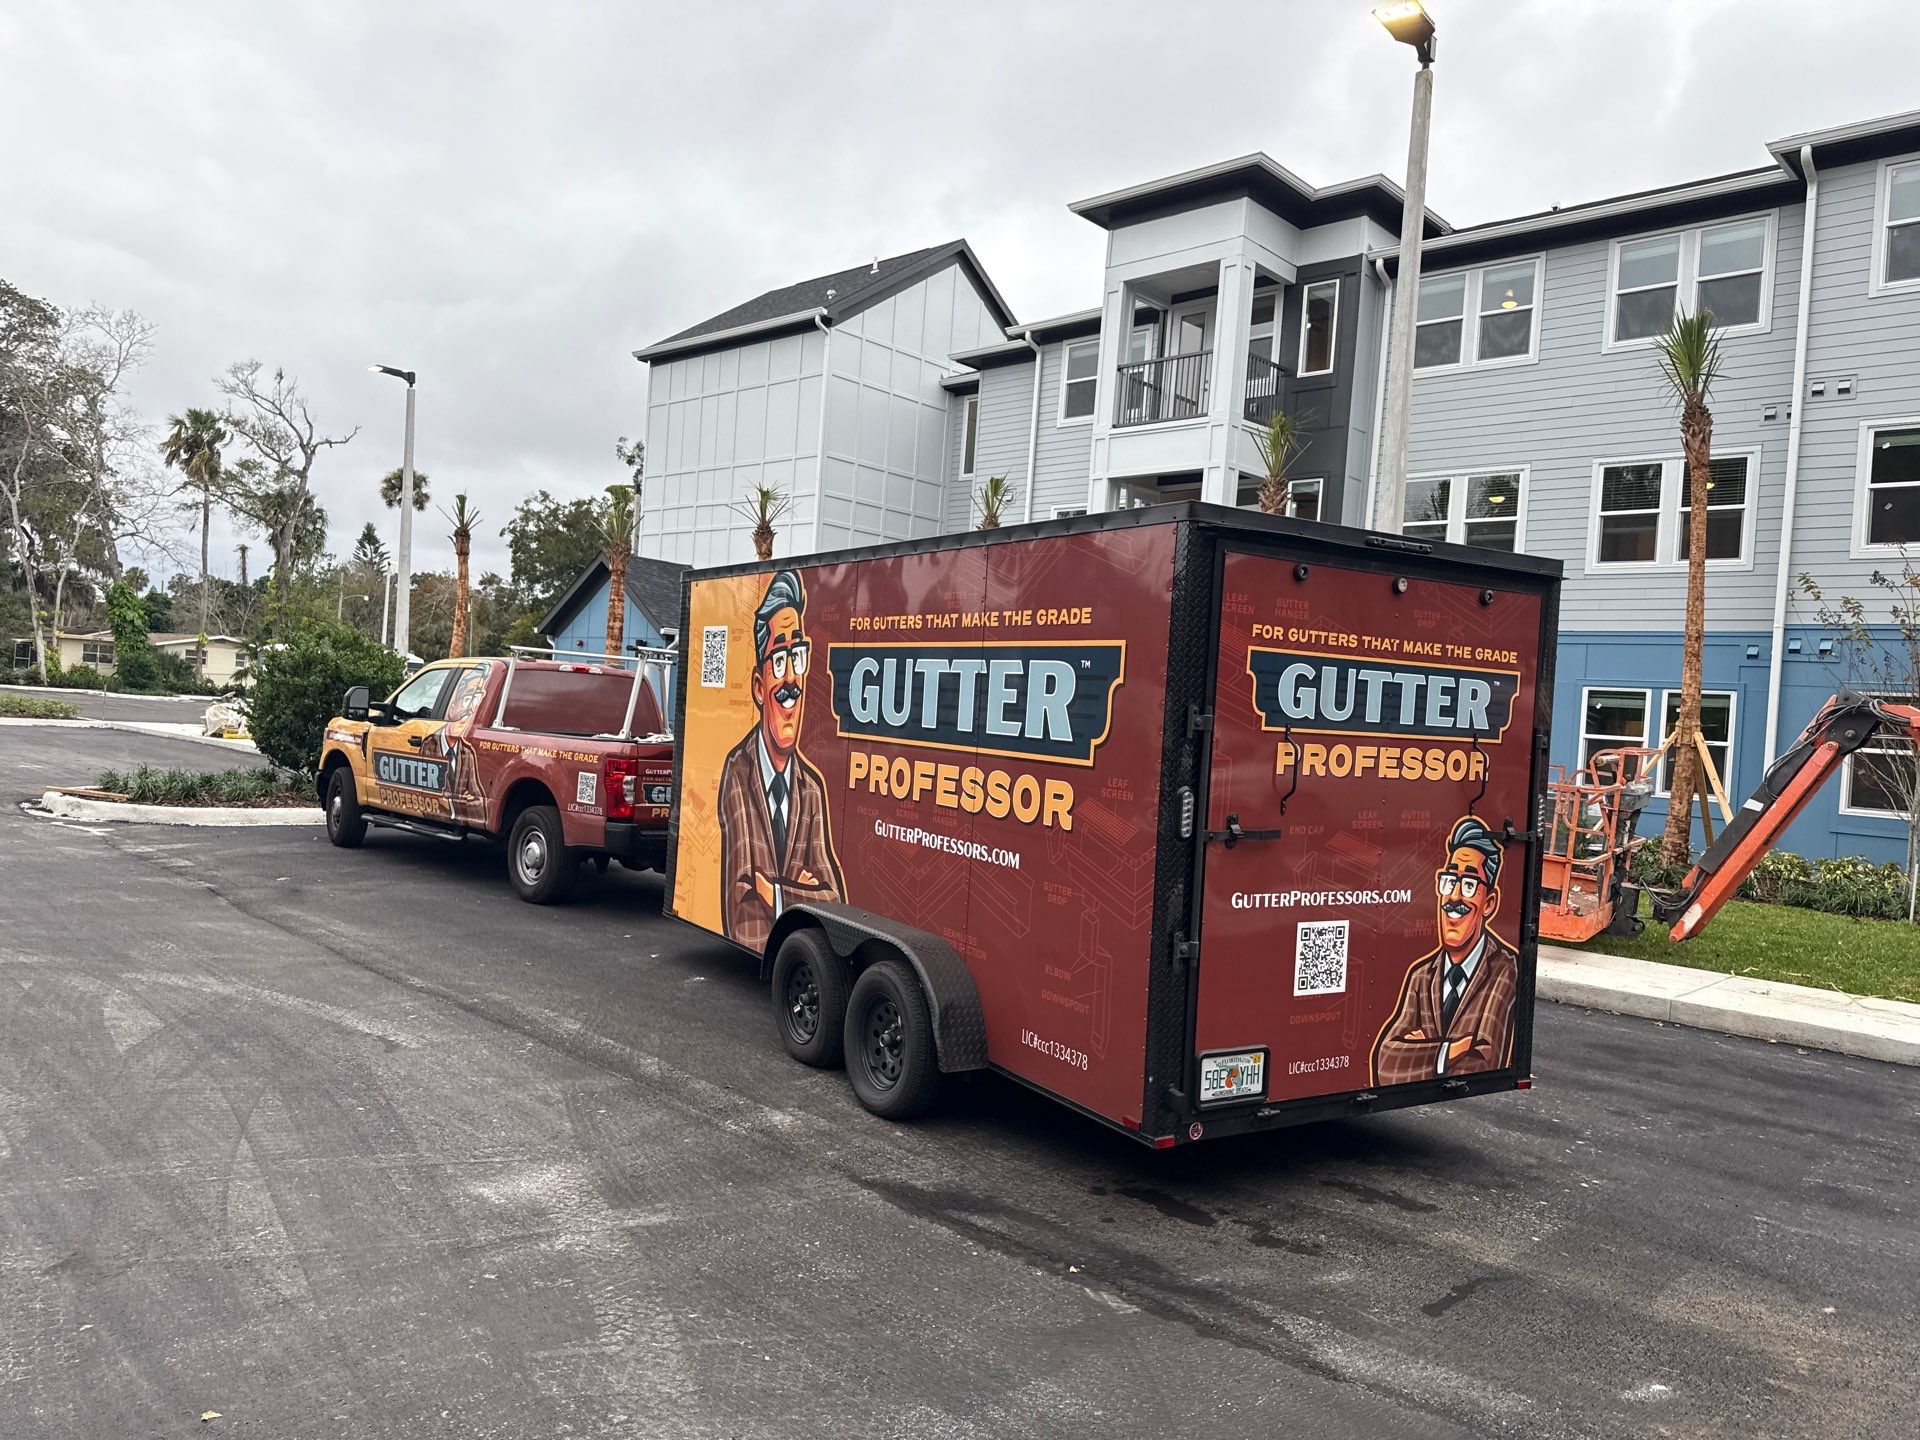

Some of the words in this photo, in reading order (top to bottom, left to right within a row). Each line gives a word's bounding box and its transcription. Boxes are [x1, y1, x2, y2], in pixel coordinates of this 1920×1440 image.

[1226, 592, 1249, 603] LEAF
[1276, 597, 1310, 611] GUTTER
[1222, 602, 1255, 615] SCREEN
[1274, 607, 1310, 621] HANGER
[849, 617, 871, 631] FOR
[873, 615, 923, 630] GUTTERS
[926, 613, 958, 629] THAT
[962, 611, 999, 628] MAKE
[1003, 610, 1032, 626] THE
[1036, 607, 1092, 625] GRADE
[1252, 623, 1284, 641] FOR
[1288, 627, 1358, 648] GUTTERS
[1362, 635, 1400, 653] THAT
[1403, 639, 1442, 657] MAKE
[1445, 644, 1472, 660] THE
[1475, 647, 1519, 664] GRADE
[849, 657, 1077, 742] GUTTER
[1278, 663, 1491, 730] GUTTER
[479, 741, 491, 750] FOR
[491, 742, 520, 753] GUTTERS
[520, 746, 537, 755] THAT
[538, 747, 558, 758] MAKE
[559, 751, 572, 760] THE
[573, 752, 599, 764] GRADE
[1276, 742, 1490, 782] PROFESSOR
[379, 756, 440, 789] GUTTER
[849, 752, 1075, 831] PROFESSOR
[1108, 776, 1128, 789] LEAF
[380, 788, 440, 814] PROFESSOR
[1101, 787, 1134, 801] SCREEN
[896, 808, 919, 821] SCREEN
[1358, 810, 1378, 820] LEAF
[1401, 810, 1431, 820] GUTTER
[1289, 825, 1307, 836] END
[1308, 825, 1325, 836] CAP
[1351, 819, 1383, 830] SCREEN
[1400, 819, 1431, 830] HANGER
[875, 819, 1020, 869] GUTTERPROFESSORS.COM
[1043, 881, 1072, 897] GUTTER
[1047, 893, 1067, 906] DROP
[1231, 888, 1412, 909] GUTTERPROFESSORS.COM
[1045, 964, 1072, 982] ELBOW
[1041, 989, 1090, 1015] DOWNSPOUT
[1290, 1011, 1342, 1025] DOWNSPOUT
[1021, 1028, 1088, 1071] LIC#ccc1334378
[1288, 1055, 1350, 1075] LIC#ccc1334378
[1240, 1064, 1260, 1087] YHH
